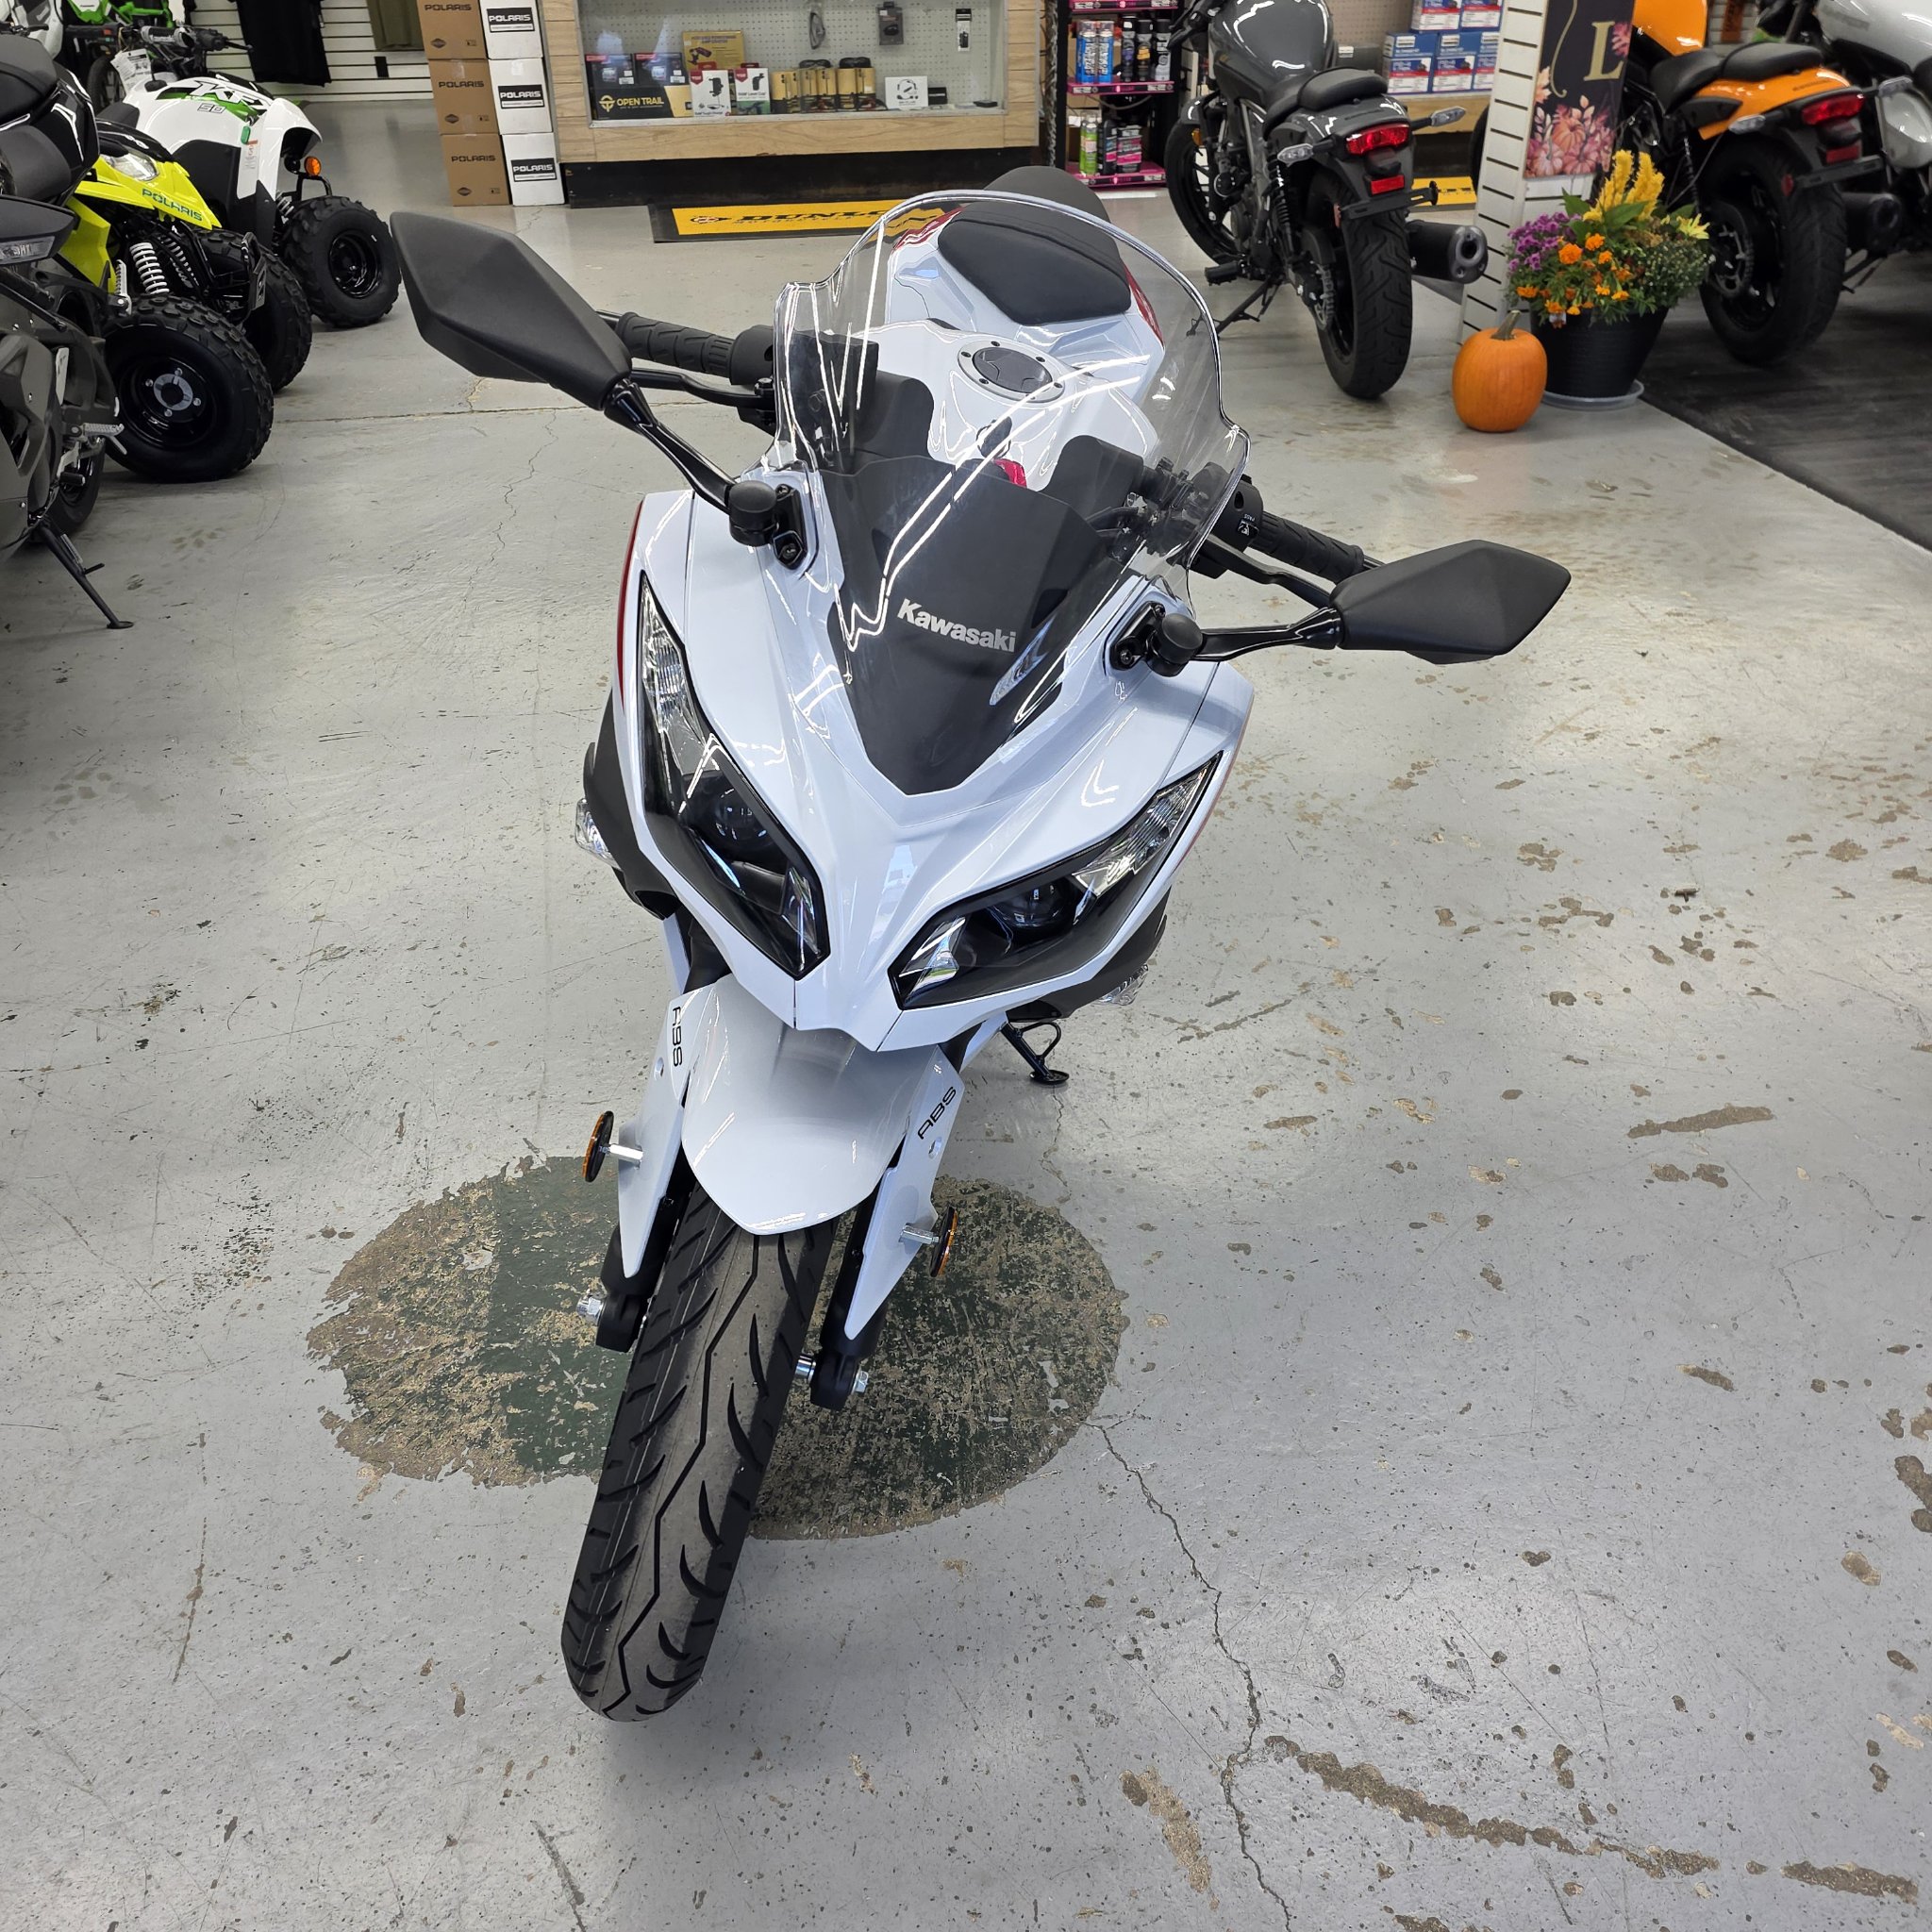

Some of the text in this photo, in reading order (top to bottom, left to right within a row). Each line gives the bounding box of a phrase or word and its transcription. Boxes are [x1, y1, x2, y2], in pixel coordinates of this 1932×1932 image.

[500, 91, 541, 99] POLARIS
[616, 96, 665, 106] OPEN TRAIL
[196, 102, 226, 114] 50
[512, 164, 553, 173] POLARIS
[142, 189, 203, 222] POLARIS
[897, 598, 1017, 653] Kawasaki
[672, 1006, 683, 1068] ABS
[916, 1086, 958, 1140] ABS
